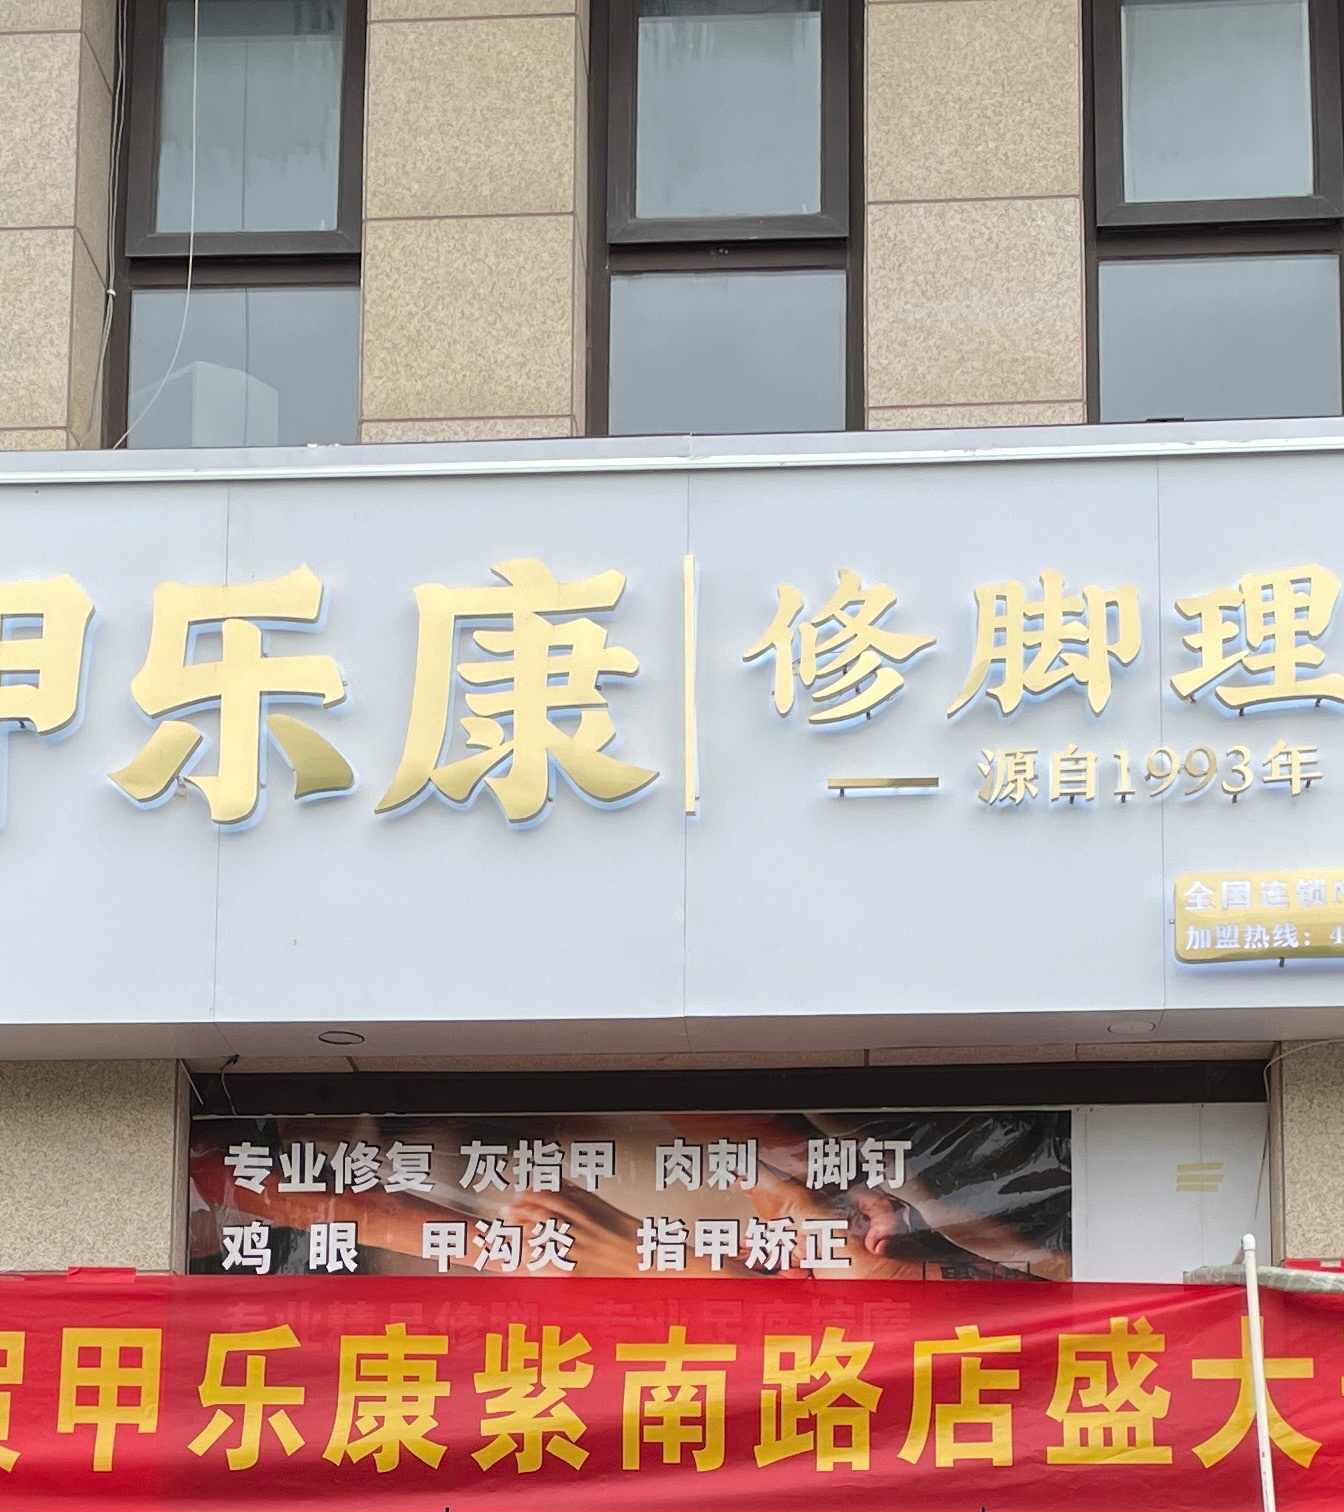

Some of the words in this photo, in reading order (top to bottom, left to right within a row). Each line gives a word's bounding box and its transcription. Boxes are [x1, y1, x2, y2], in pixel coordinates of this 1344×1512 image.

[976, 739, 1324, 807] 源自1993年
[224, 1140, 435, 1196] 专业修复
[458, 1138, 618, 1194] 灰指甲
[654, 1137, 758, 1192] 肉刺
[805, 1137, 912, 1190] 脚钉
[421, 1219, 578, 1274] 甲沟炎
[636, 1217, 853, 1272] 指甲矫正
